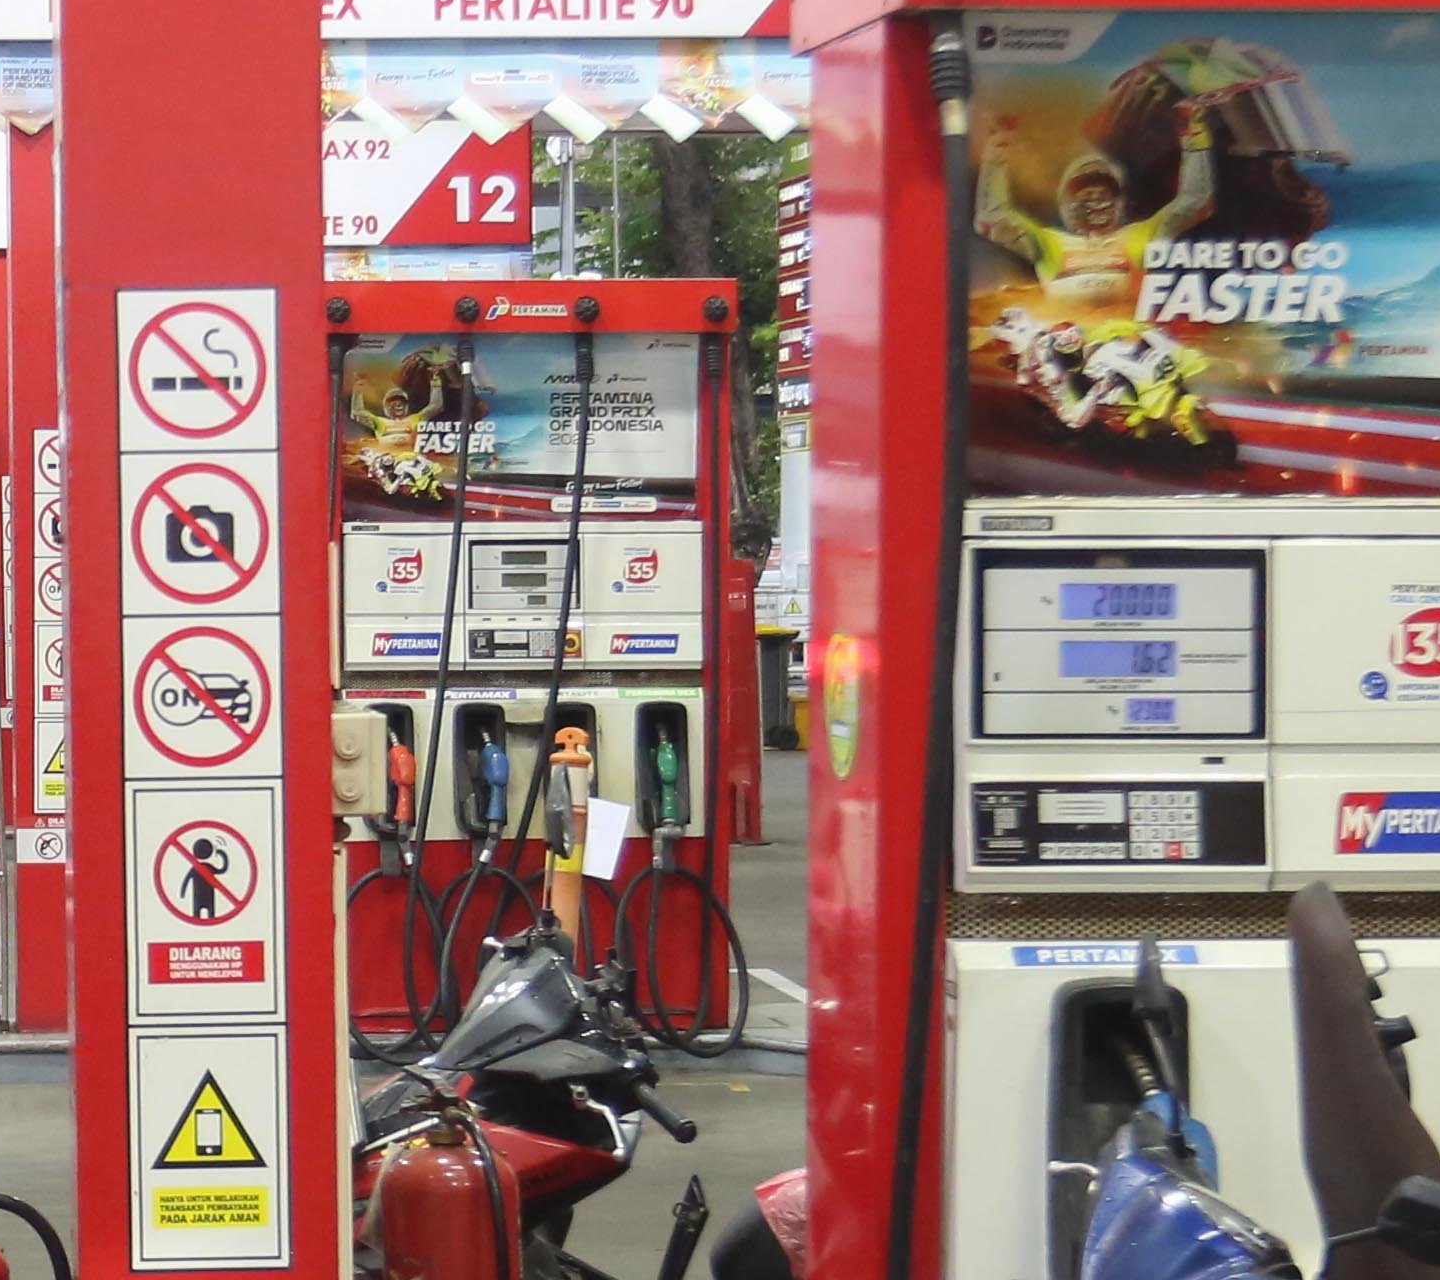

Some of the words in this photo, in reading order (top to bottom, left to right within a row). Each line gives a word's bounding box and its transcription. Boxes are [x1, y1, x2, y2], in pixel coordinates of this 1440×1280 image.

[446, 175, 517, 224] 12
[1142, 241, 1235, 270] DARE
[1239, 241, 1286, 270] TO
[1291, 241, 1349, 270] GO
[1134, 274, 1349, 324] FASTER
[169, 946, 242, 961] DILARANG
[159, 1195, 185, 1204] HANYA
[186, 1195, 213, 1203] UNTUK
[159, 1203, 205, 1213] TRANSAKSI
[159, 1212, 188, 1225] PADA
[190, 1212, 226, 1225] JARAK
[229, 1212, 260, 1224] AMAN
